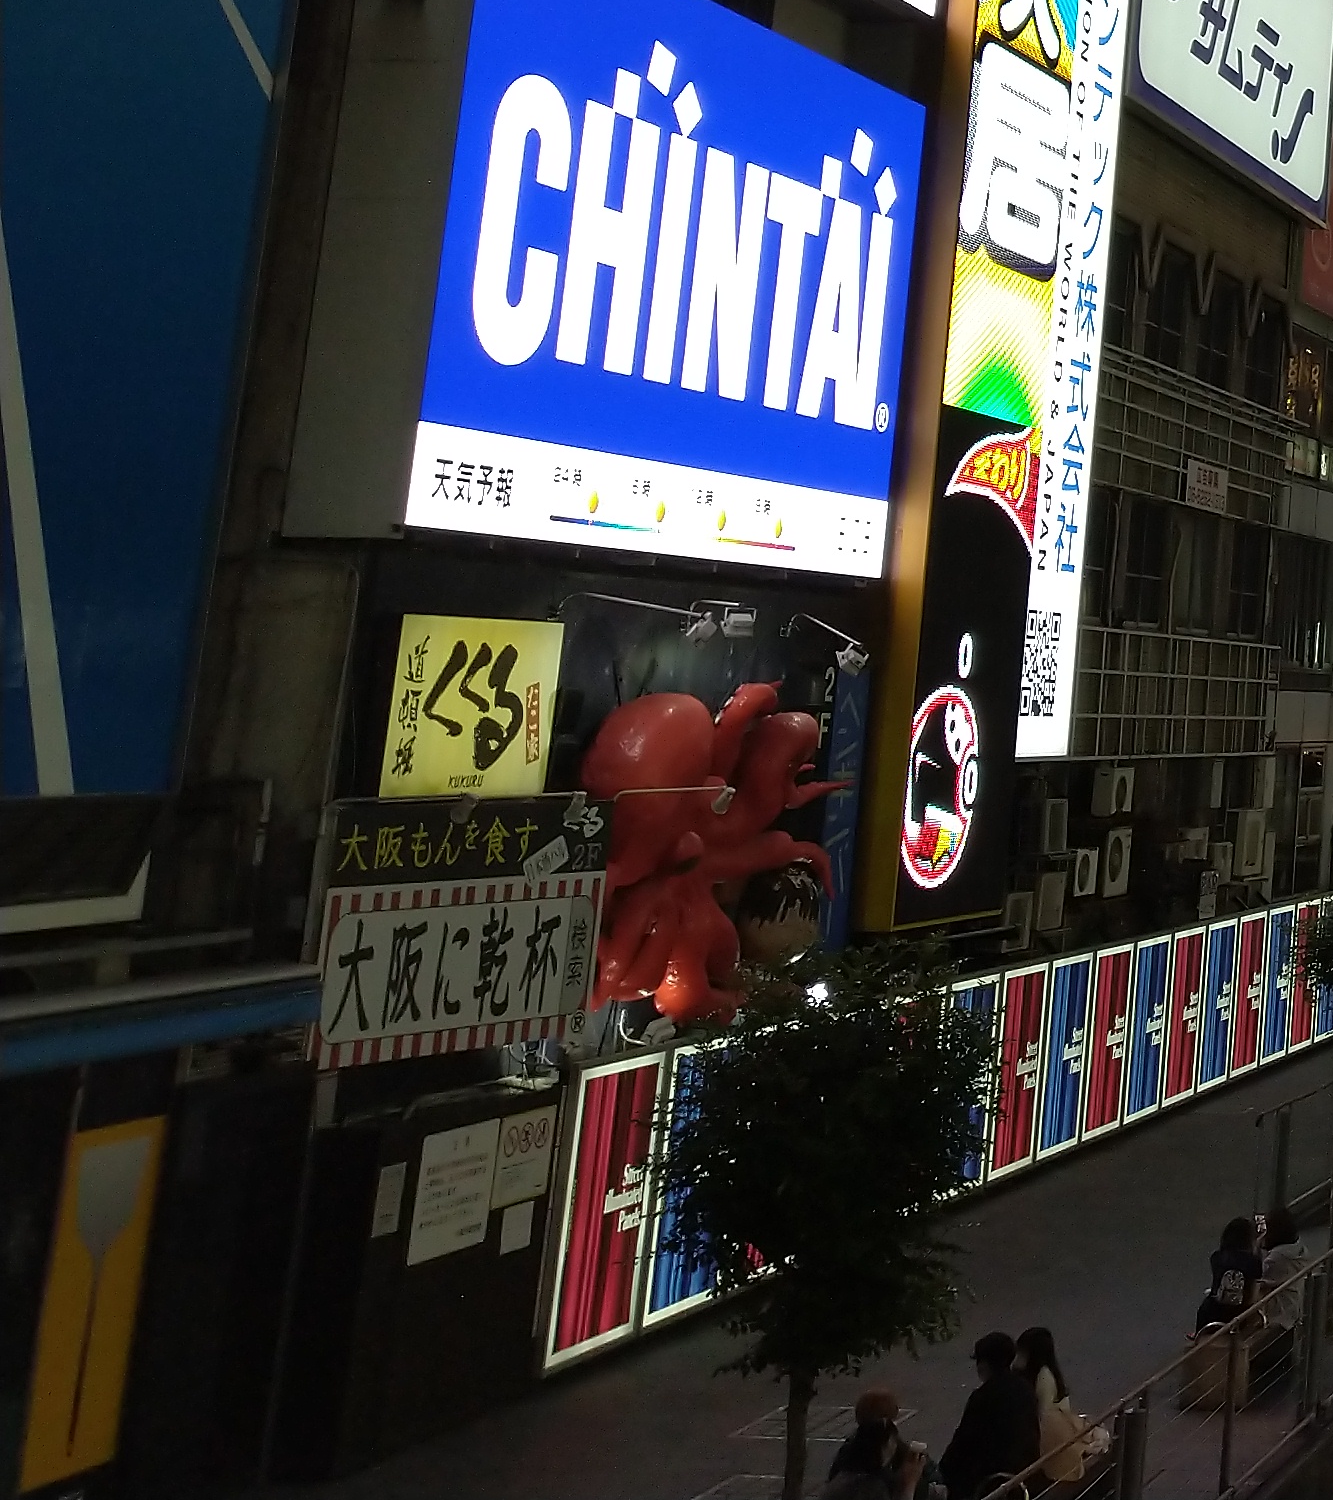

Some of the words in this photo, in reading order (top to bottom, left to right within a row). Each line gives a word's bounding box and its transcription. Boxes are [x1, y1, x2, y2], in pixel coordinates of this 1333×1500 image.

[471, 40, 908, 431] CHINTAI
[1053, 240, 1075, 385] WORLD
[430, 455, 516, 508] 天気予報
[1035, 437, 1056, 572] JAPAN
[391, 635, 432, 778] 道頓堀
[422, 639, 524, 770] くくる
[336, 816, 540, 873] 大阪もんを食す
[446, 773, 485, 789] KUKURU
[327, 903, 563, 1037] 大阪に乾杯
